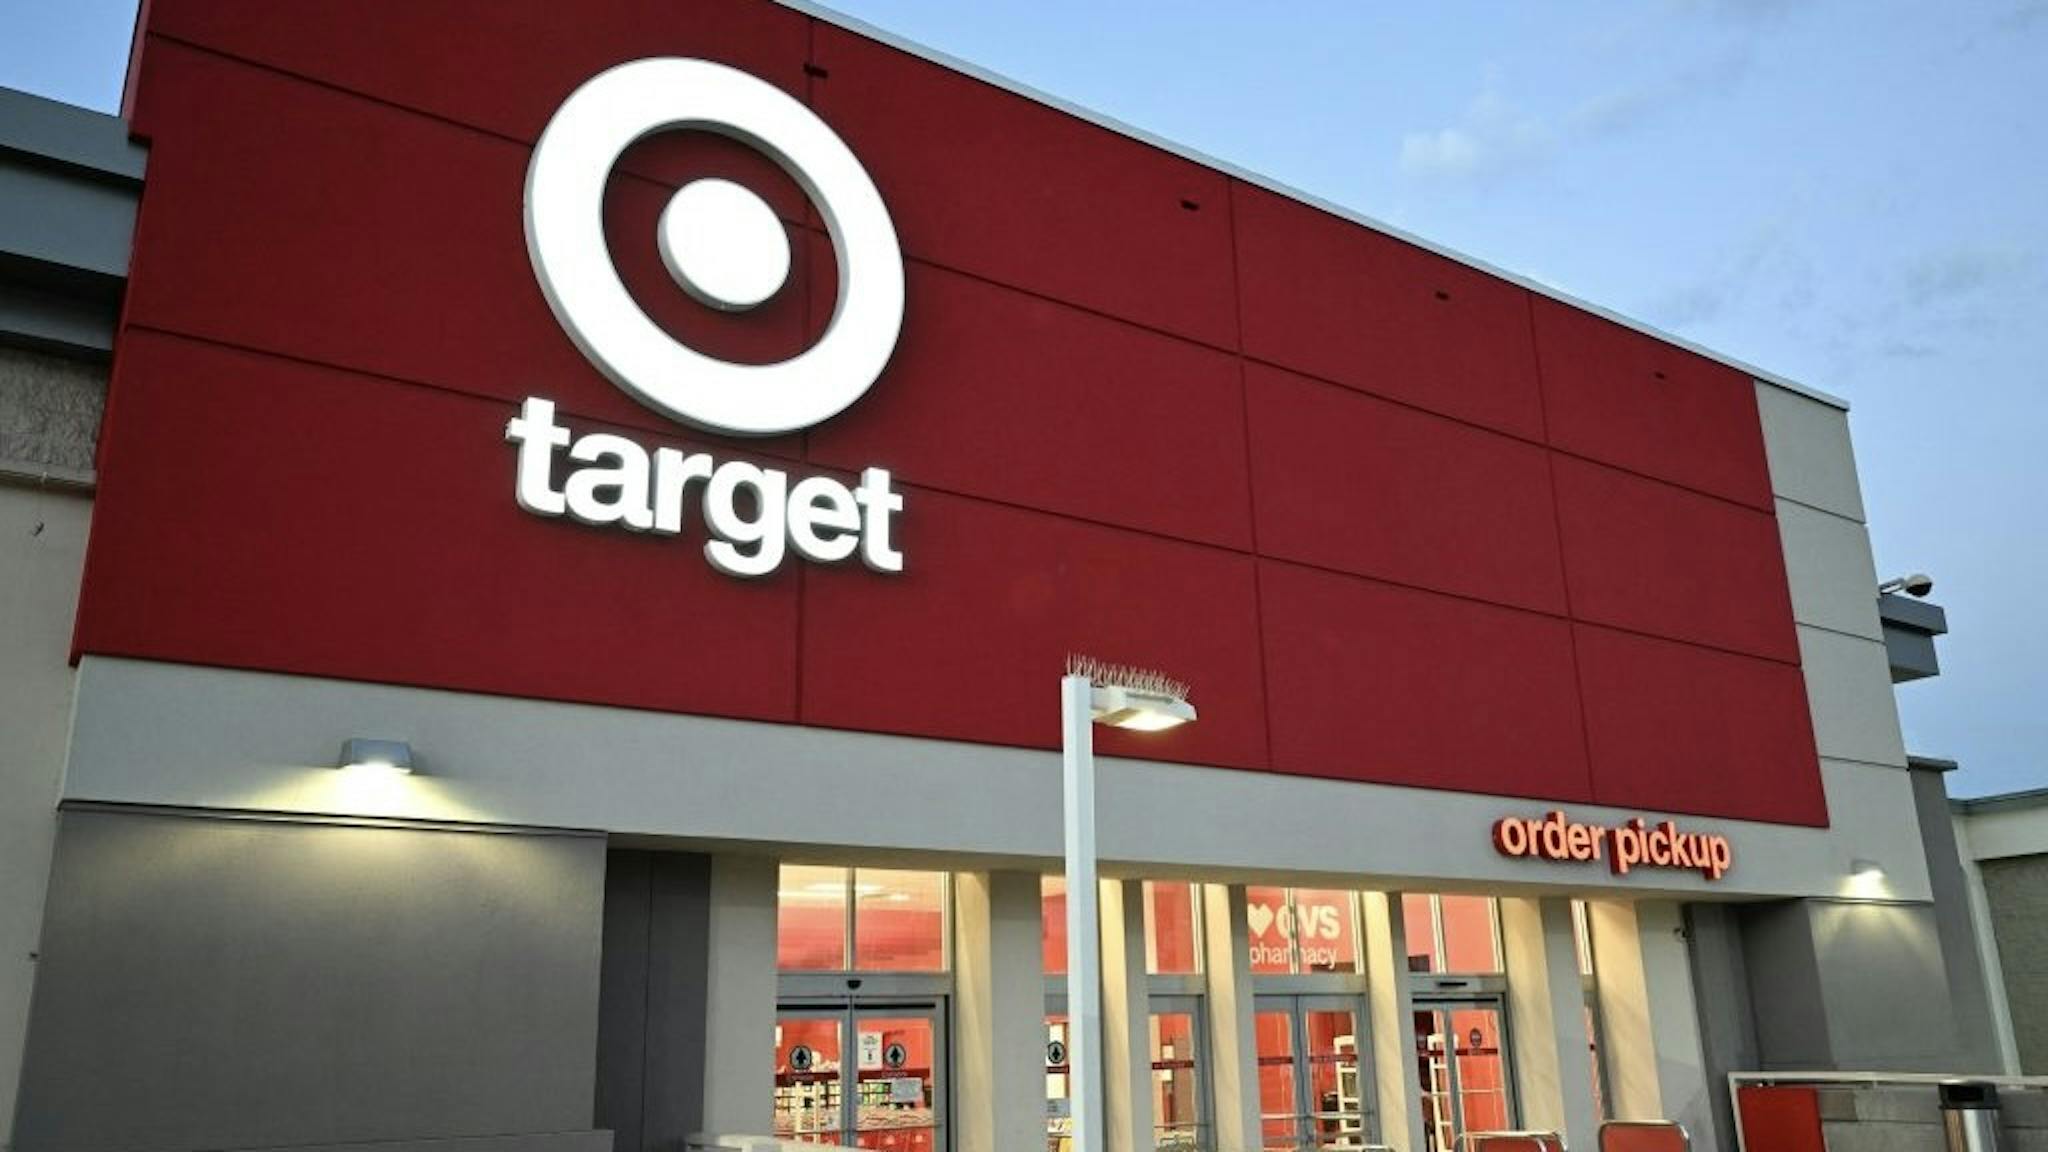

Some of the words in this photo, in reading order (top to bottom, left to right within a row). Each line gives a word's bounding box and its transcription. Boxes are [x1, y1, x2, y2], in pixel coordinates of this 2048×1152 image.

[506, 397, 903, 577] target
[1496, 811, 1605, 860] order
[1611, 818, 1731, 880] pickup
